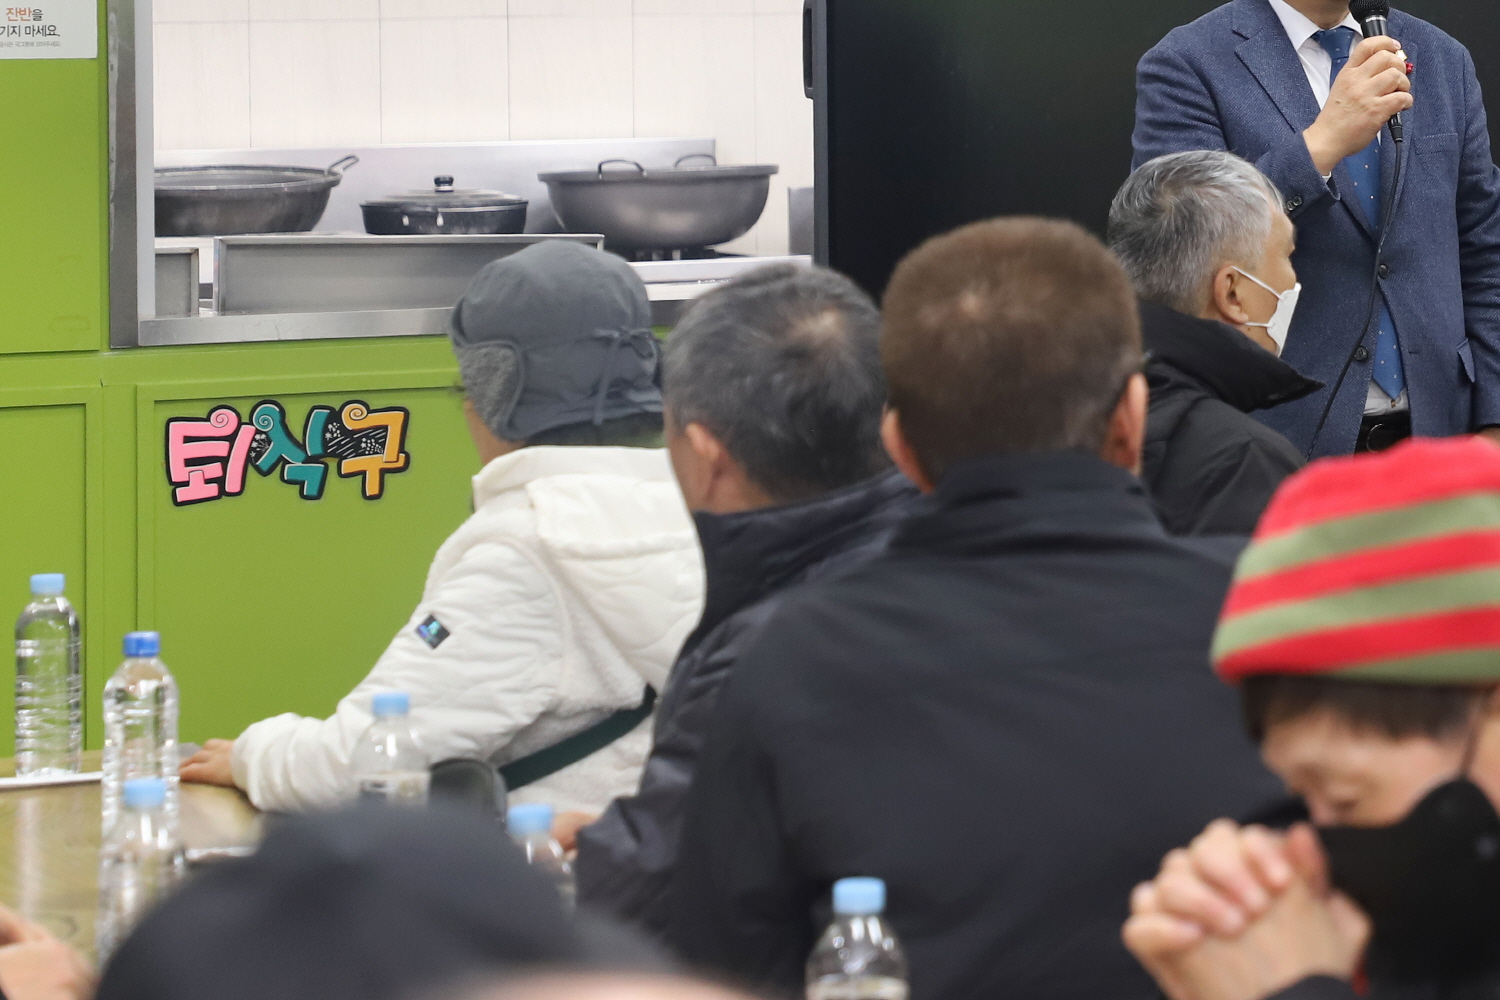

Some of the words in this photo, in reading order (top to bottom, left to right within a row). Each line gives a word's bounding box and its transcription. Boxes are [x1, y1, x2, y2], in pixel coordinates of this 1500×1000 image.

[6, 7, 43, 22] 잔반을
[24, 25, 61, 37] 마세요.
[167, 401, 410, 505] 퇴식구
